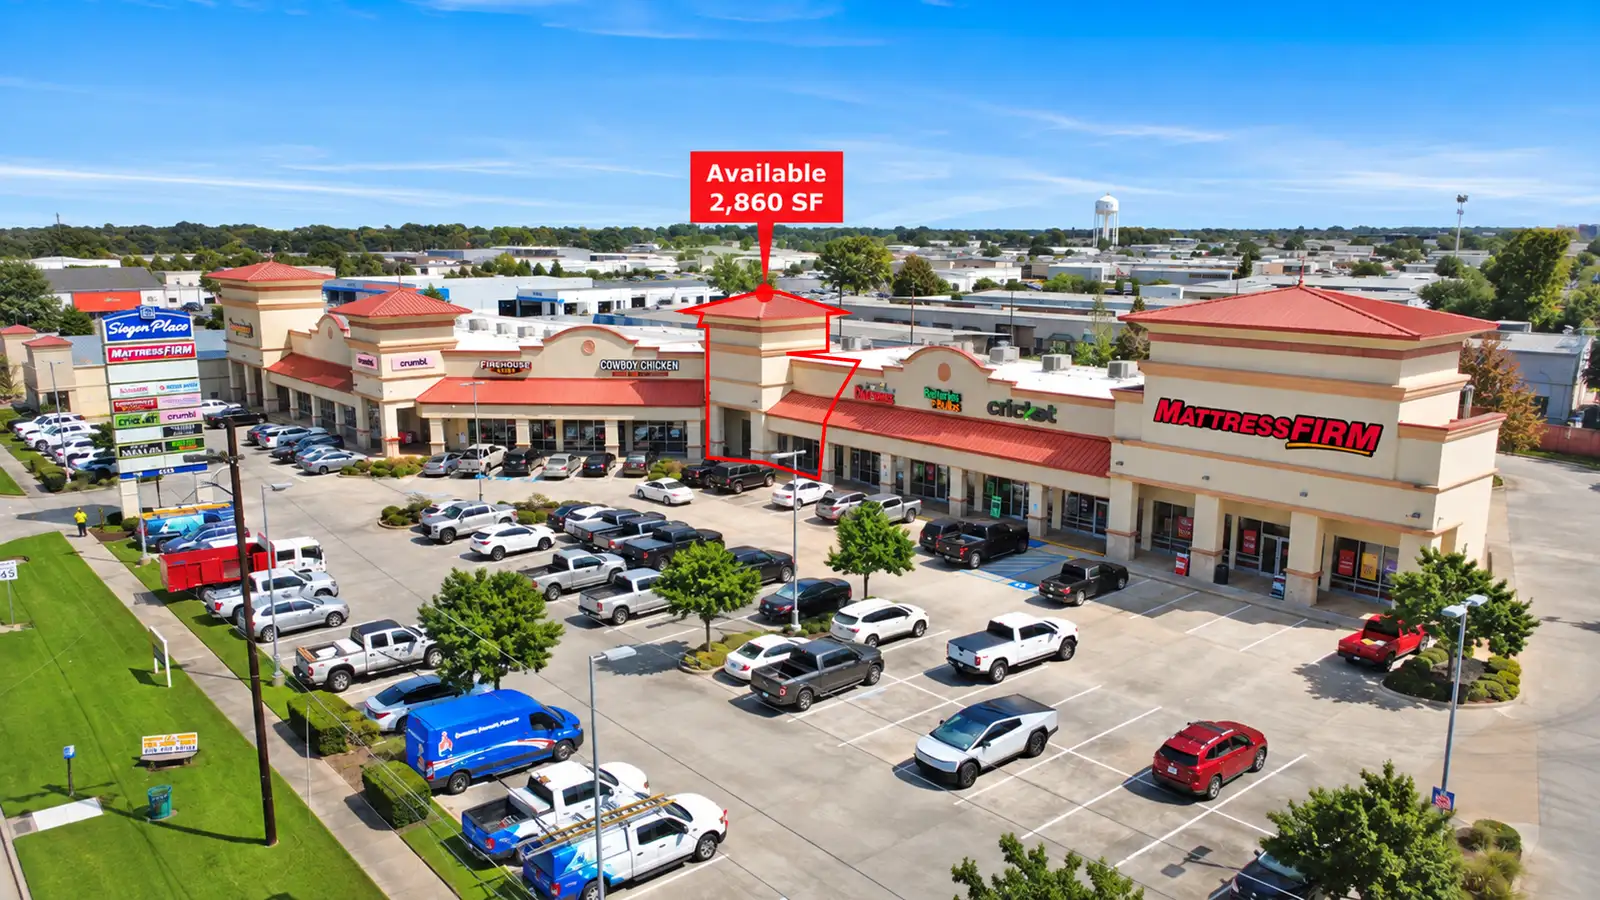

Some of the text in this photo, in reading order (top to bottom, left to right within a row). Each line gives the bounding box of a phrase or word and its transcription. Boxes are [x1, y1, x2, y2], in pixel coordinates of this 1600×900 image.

[400, 357, 428, 367] crumbl
[600, 360, 679, 370] COWBOY CHICKEN
[1153, 397, 1383, 453] MATTRESSFIRM
